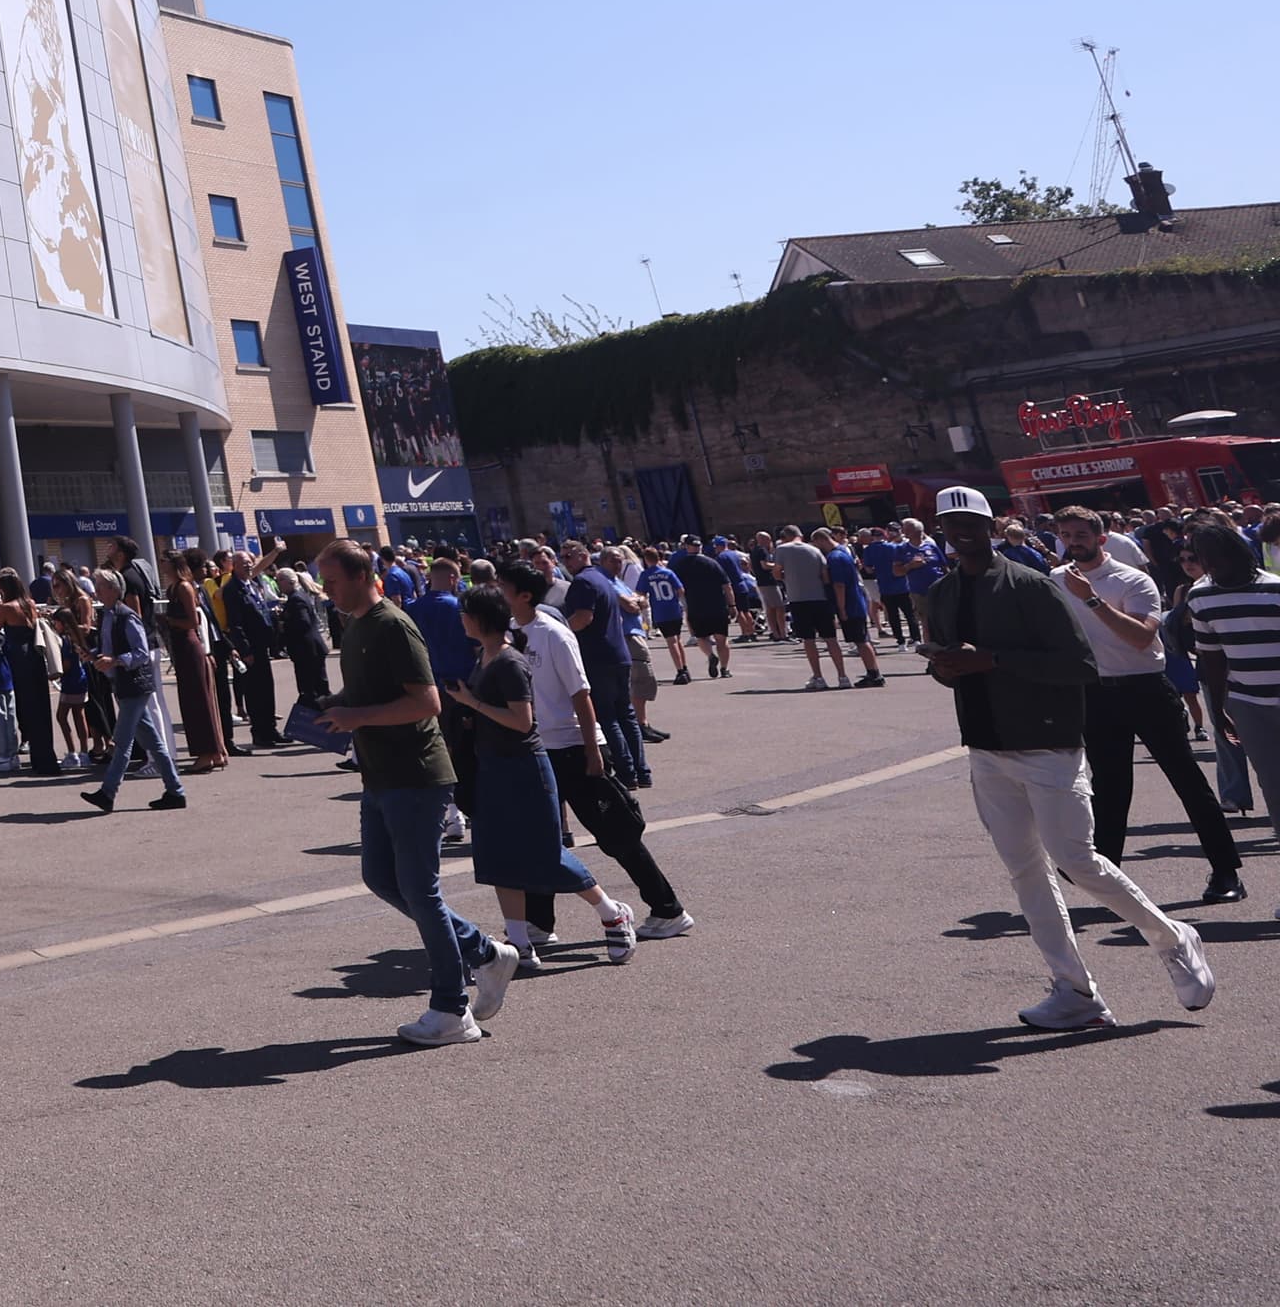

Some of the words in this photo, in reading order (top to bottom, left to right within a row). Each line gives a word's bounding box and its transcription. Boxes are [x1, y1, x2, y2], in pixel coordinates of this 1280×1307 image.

[295, 261, 318, 316] WEST
[307, 324, 331, 391] STAND
[1032, 462, 1079, 480] CHICKEN
[1092, 457, 1134, 474] SHRIMP
[383, 503, 409, 512] ELCOME
[409, 502, 418, 512] TO
[419, 502, 430, 511] THE
[649, 580, 674, 601] 10
